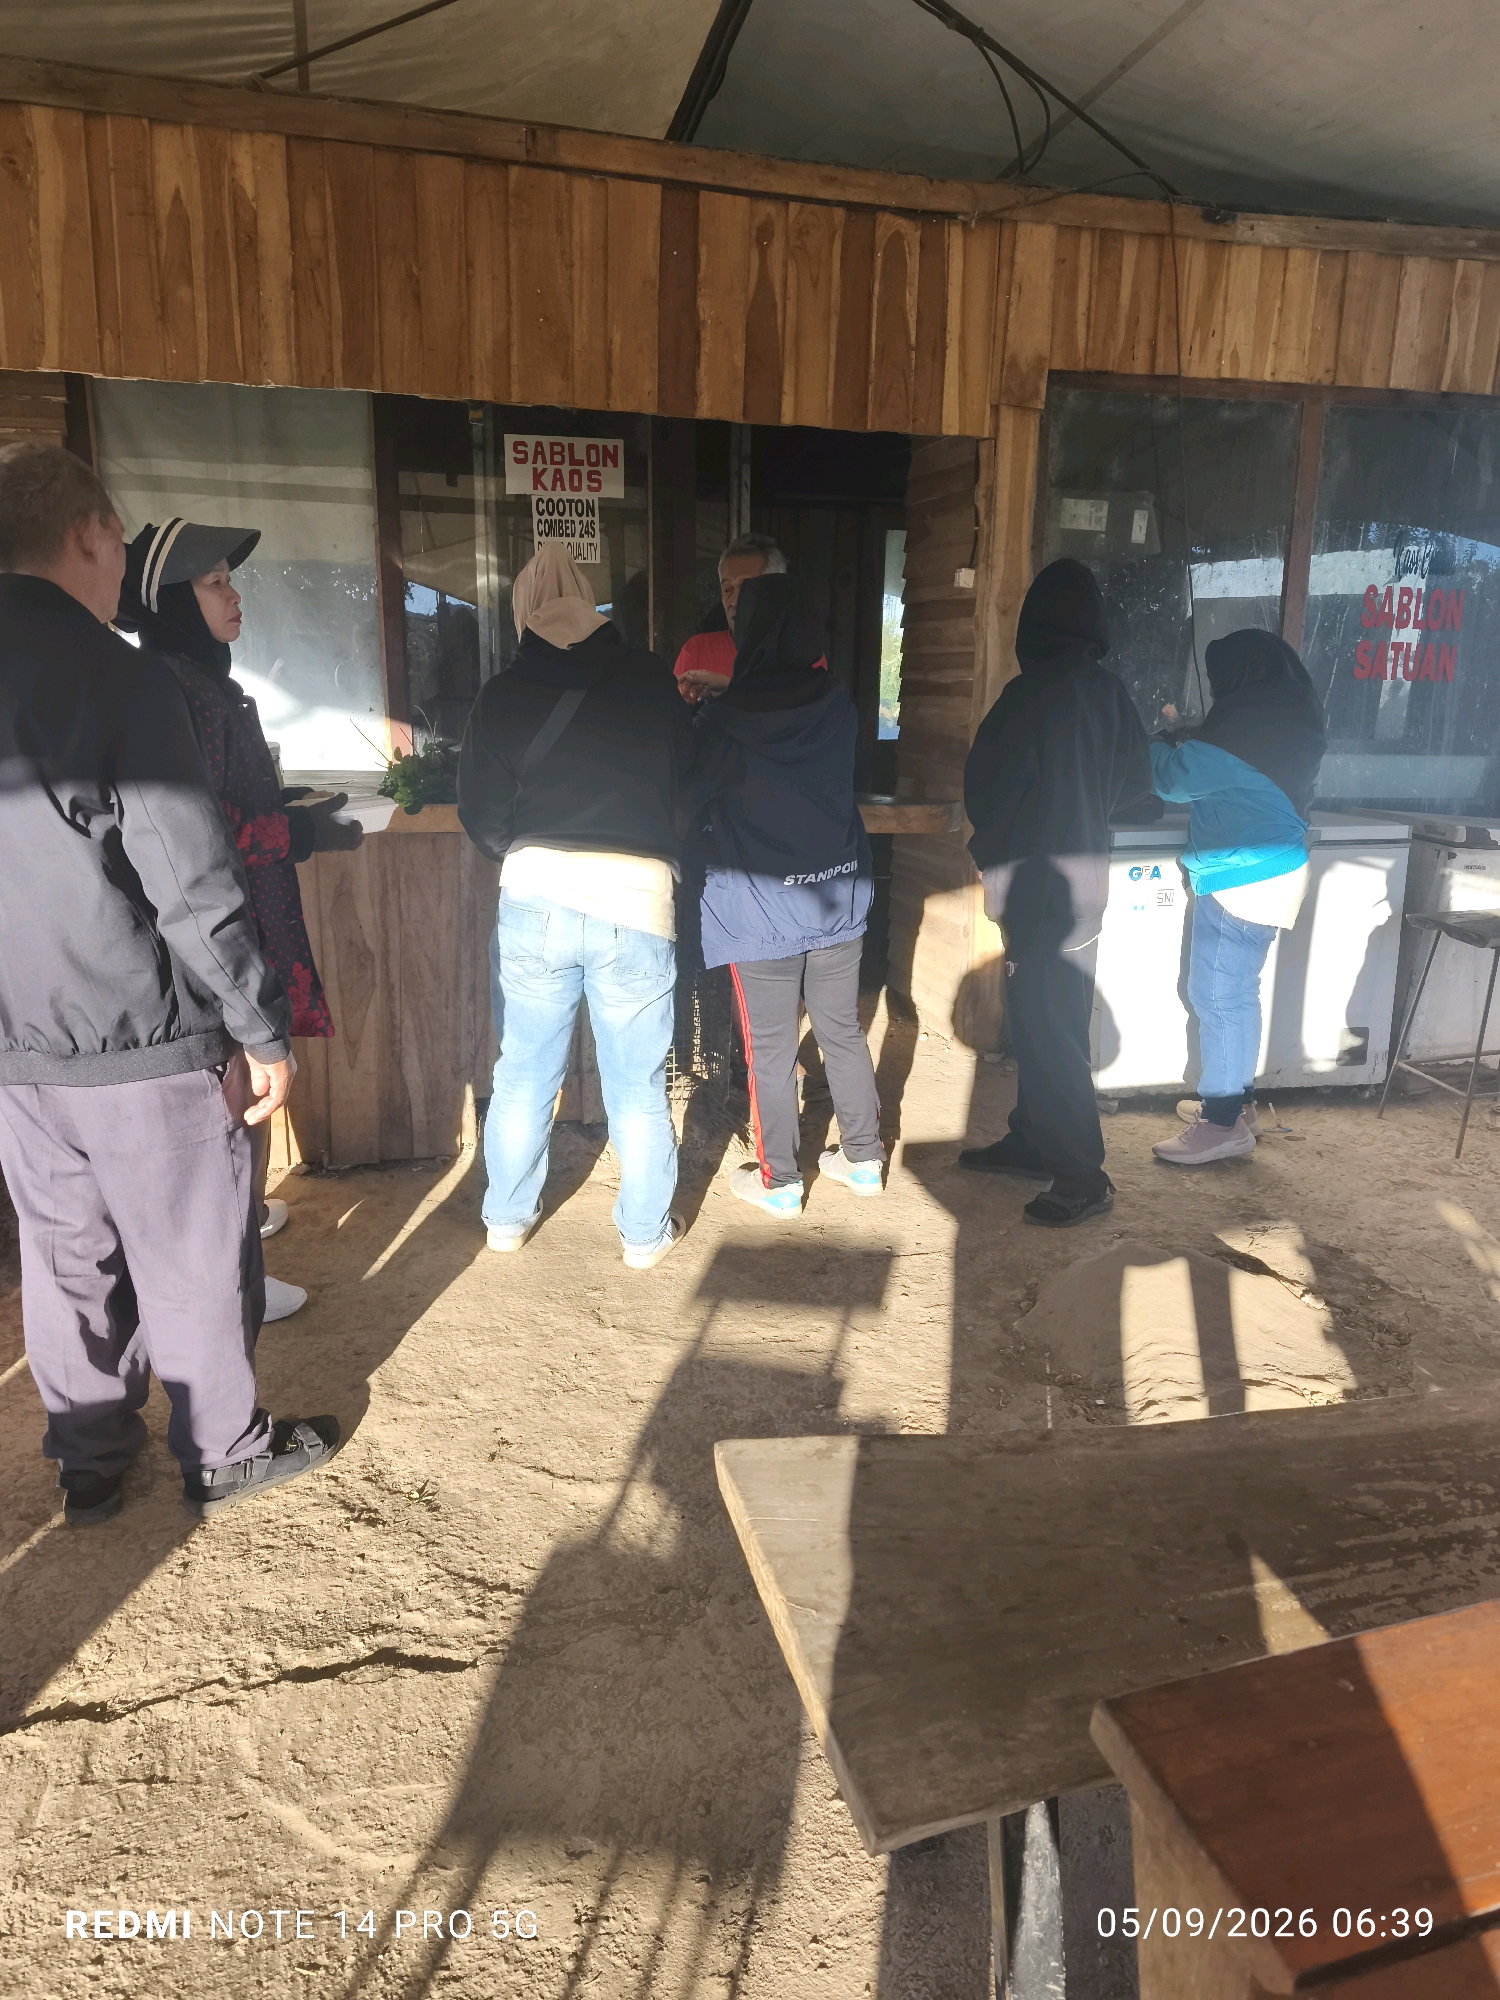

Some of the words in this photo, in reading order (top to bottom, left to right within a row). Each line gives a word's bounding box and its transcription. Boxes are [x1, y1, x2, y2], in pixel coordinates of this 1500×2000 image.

[512, 440, 619, 468] SABLON
[532, 466, 603, 493] KAOS
[535, 497, 596, 518] COOTON
[536, 518, 576, 538] COMBED
[578, 519, 596, 539] 24S
[1361, 583, 1465, 632] SABLON
[1353, 640, 1458, 683] SATUAN
